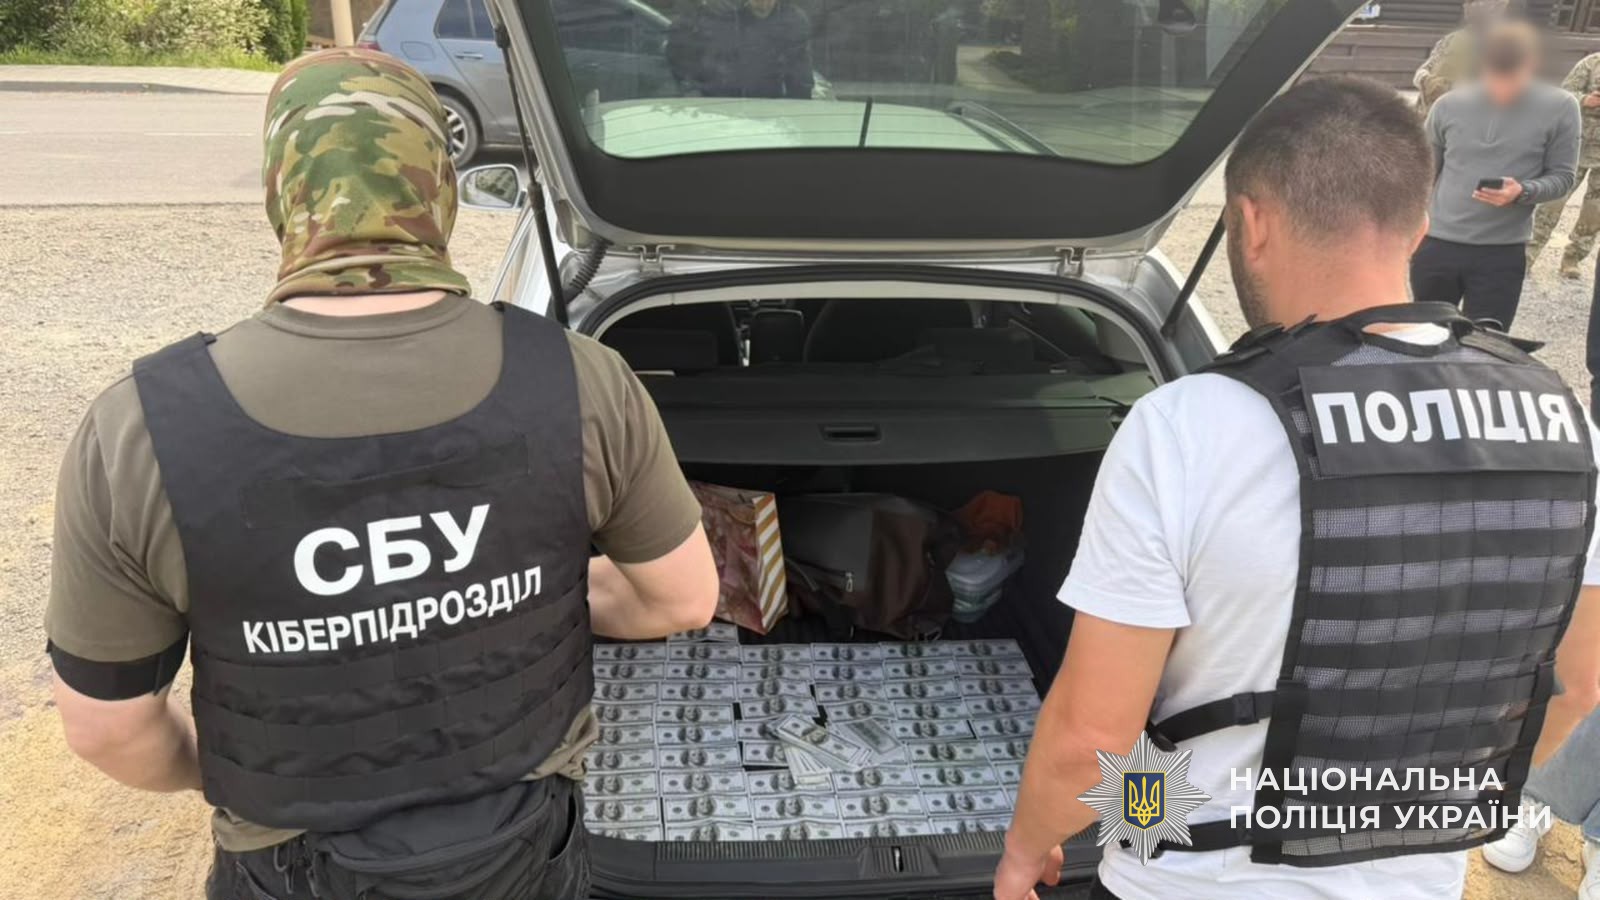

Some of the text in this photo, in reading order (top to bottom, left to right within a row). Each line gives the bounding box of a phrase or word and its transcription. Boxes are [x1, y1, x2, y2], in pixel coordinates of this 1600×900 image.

[1311, 388, 1580, 444] ПОЛІЦІЯ
[294, 504, 490, 596] СБУ
[243, 566, 542, 653] КІБЕРПІДРОЗДІЛ
